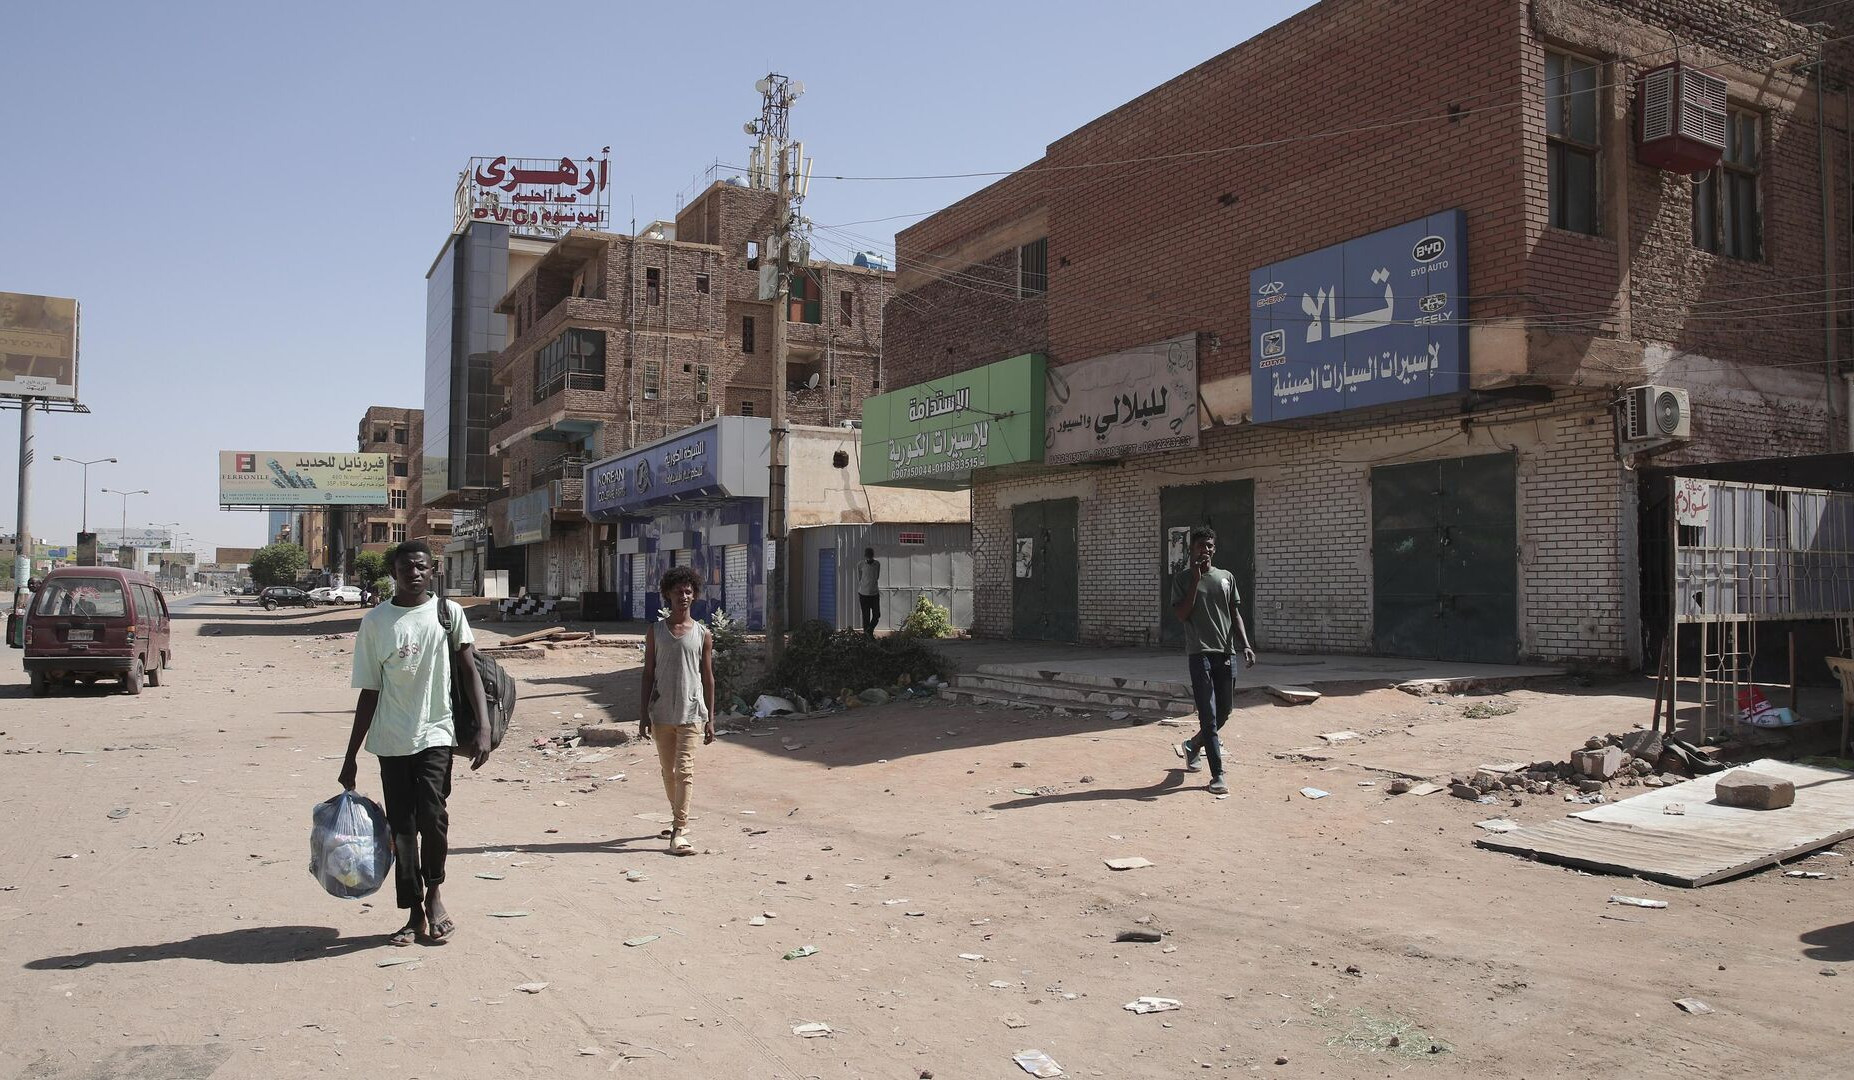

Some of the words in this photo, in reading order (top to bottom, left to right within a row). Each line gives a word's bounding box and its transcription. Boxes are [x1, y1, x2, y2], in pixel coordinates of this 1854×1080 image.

[475, 145, 610, 196] أزهري
[512, 187, 552, 206] الحليم
[554, 190, 577, 207] عبد
[473, 207, 529, 225] PVC
[1416, 241, 1441, 258] BYD
[1410, 265, 1426, 277] BYD
[1427, 260, 1449, 274] AUTO
[1257, 292, 1287, 308] CHERY
[1414, 311, 1453, 327] GEELY
[1380, 341, 1440, 385] لإسبيرات
[1321, 355, 1377, 393] السيارات
[1273, 368, 1319, 404] الصينية
[908, 387, 970, 421] الإستدامة
[1095, 385, 1168, 440] للبلالي
[1057, 413, 1092, 433] والسيور
[889, 432, 929, 468] الكورية
[295, 456, 336, 472] للحديد
[339, 456, 385, 472] فيرونايل
[597, 467, 625, 487] KOREAN
